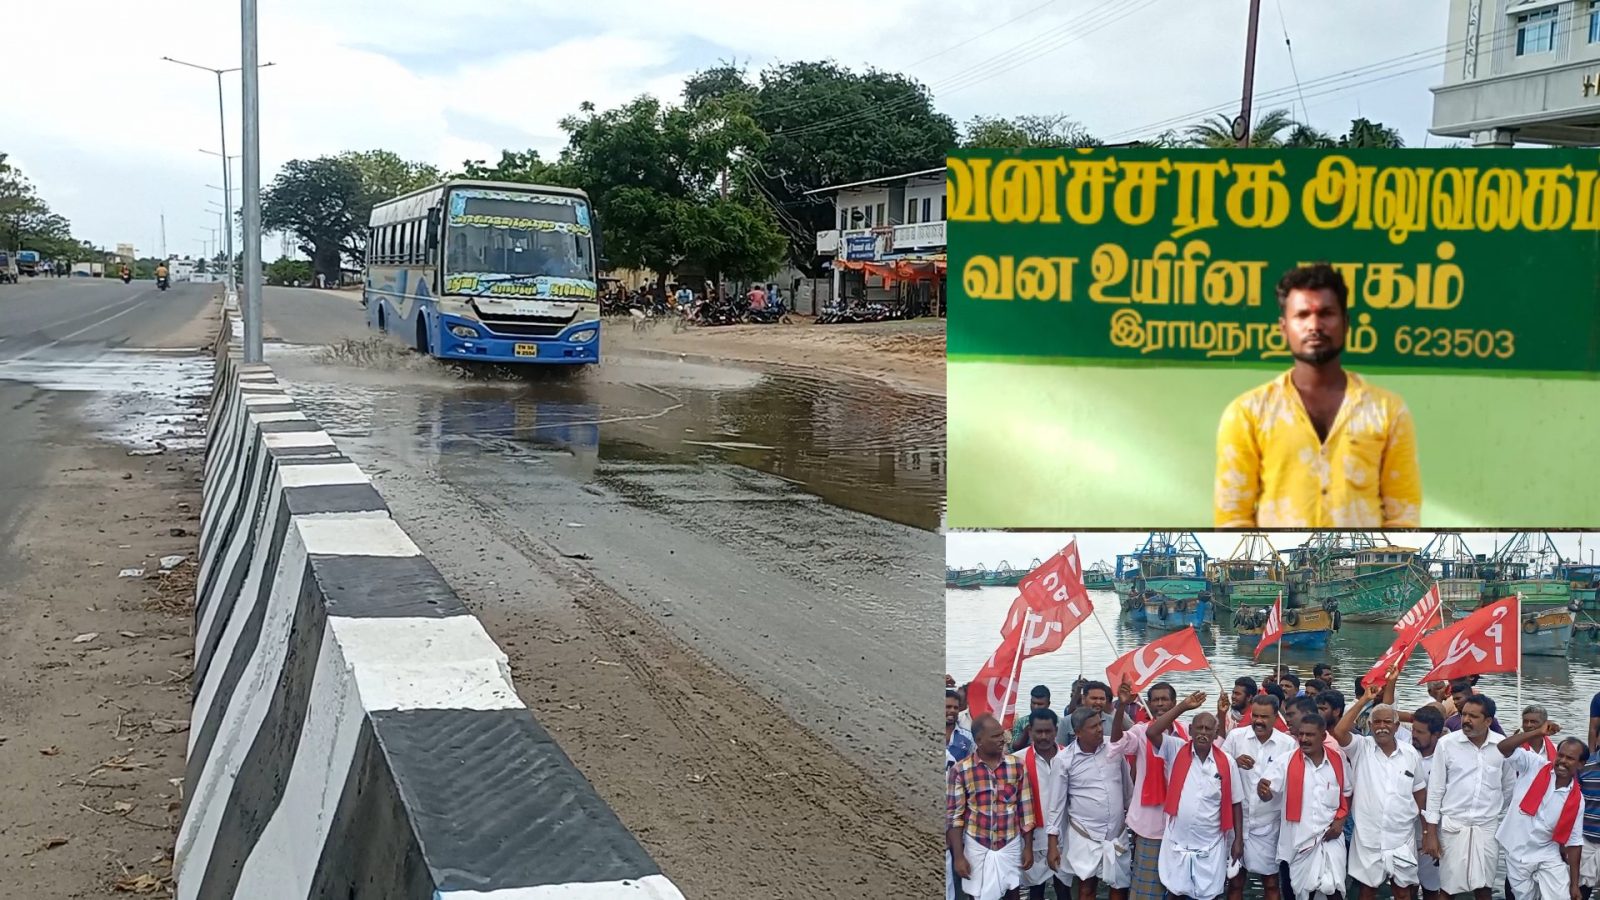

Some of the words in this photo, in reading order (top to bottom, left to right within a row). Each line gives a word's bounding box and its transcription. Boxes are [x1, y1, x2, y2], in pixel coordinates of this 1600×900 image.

[963, 255, 1079, 301] வன
[1089, 242, 1268, 306] உயிரின
[1394, 326, 1516, 358] 623503
